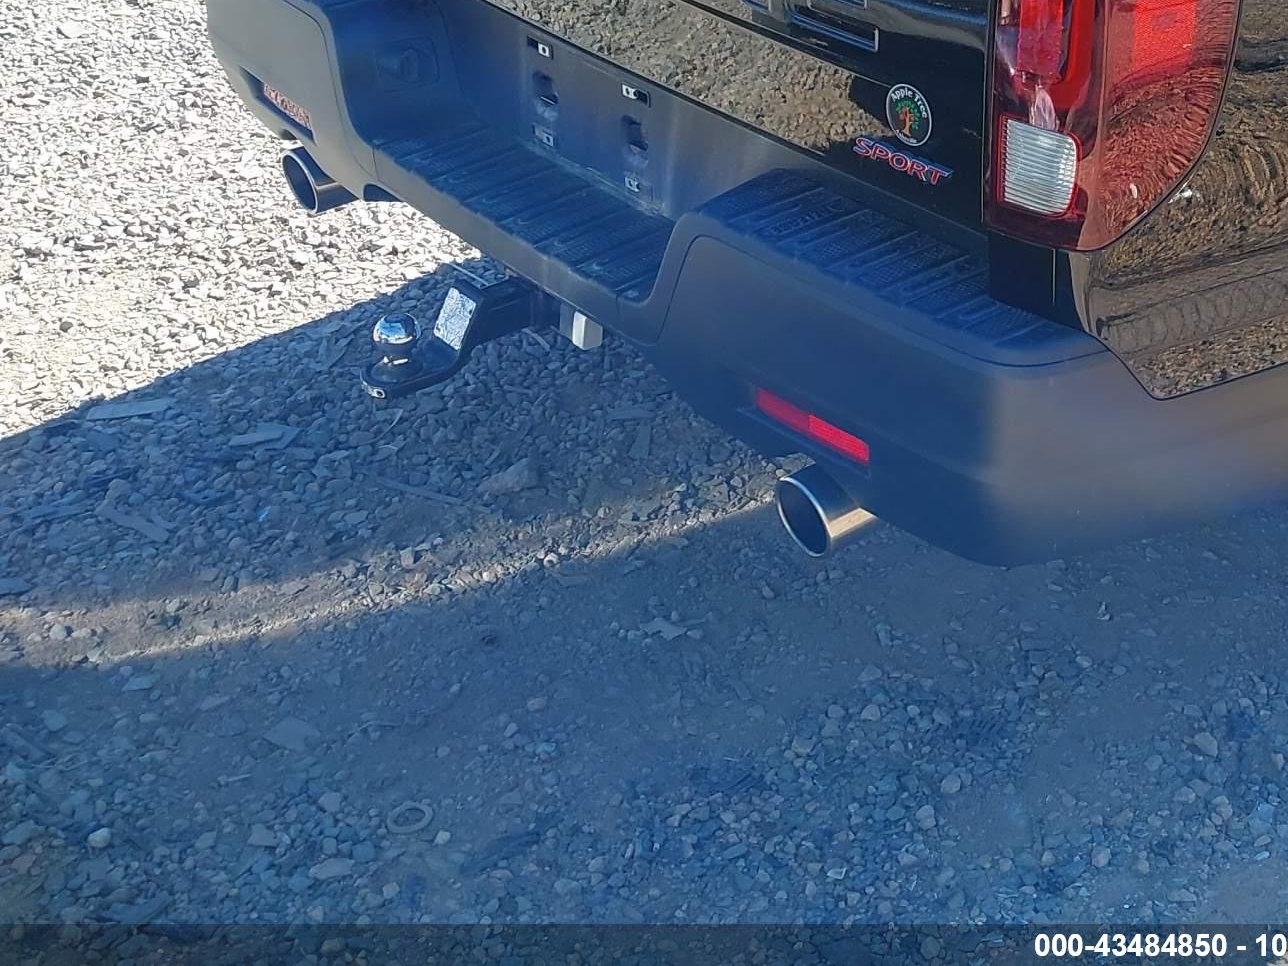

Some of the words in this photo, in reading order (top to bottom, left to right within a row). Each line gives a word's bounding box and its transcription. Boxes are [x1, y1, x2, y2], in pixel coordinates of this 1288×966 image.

[891, 87, 913, 103] Apple
[914, 93, 928, 119] Tree
[852, 136, 954, 185] SPORT
